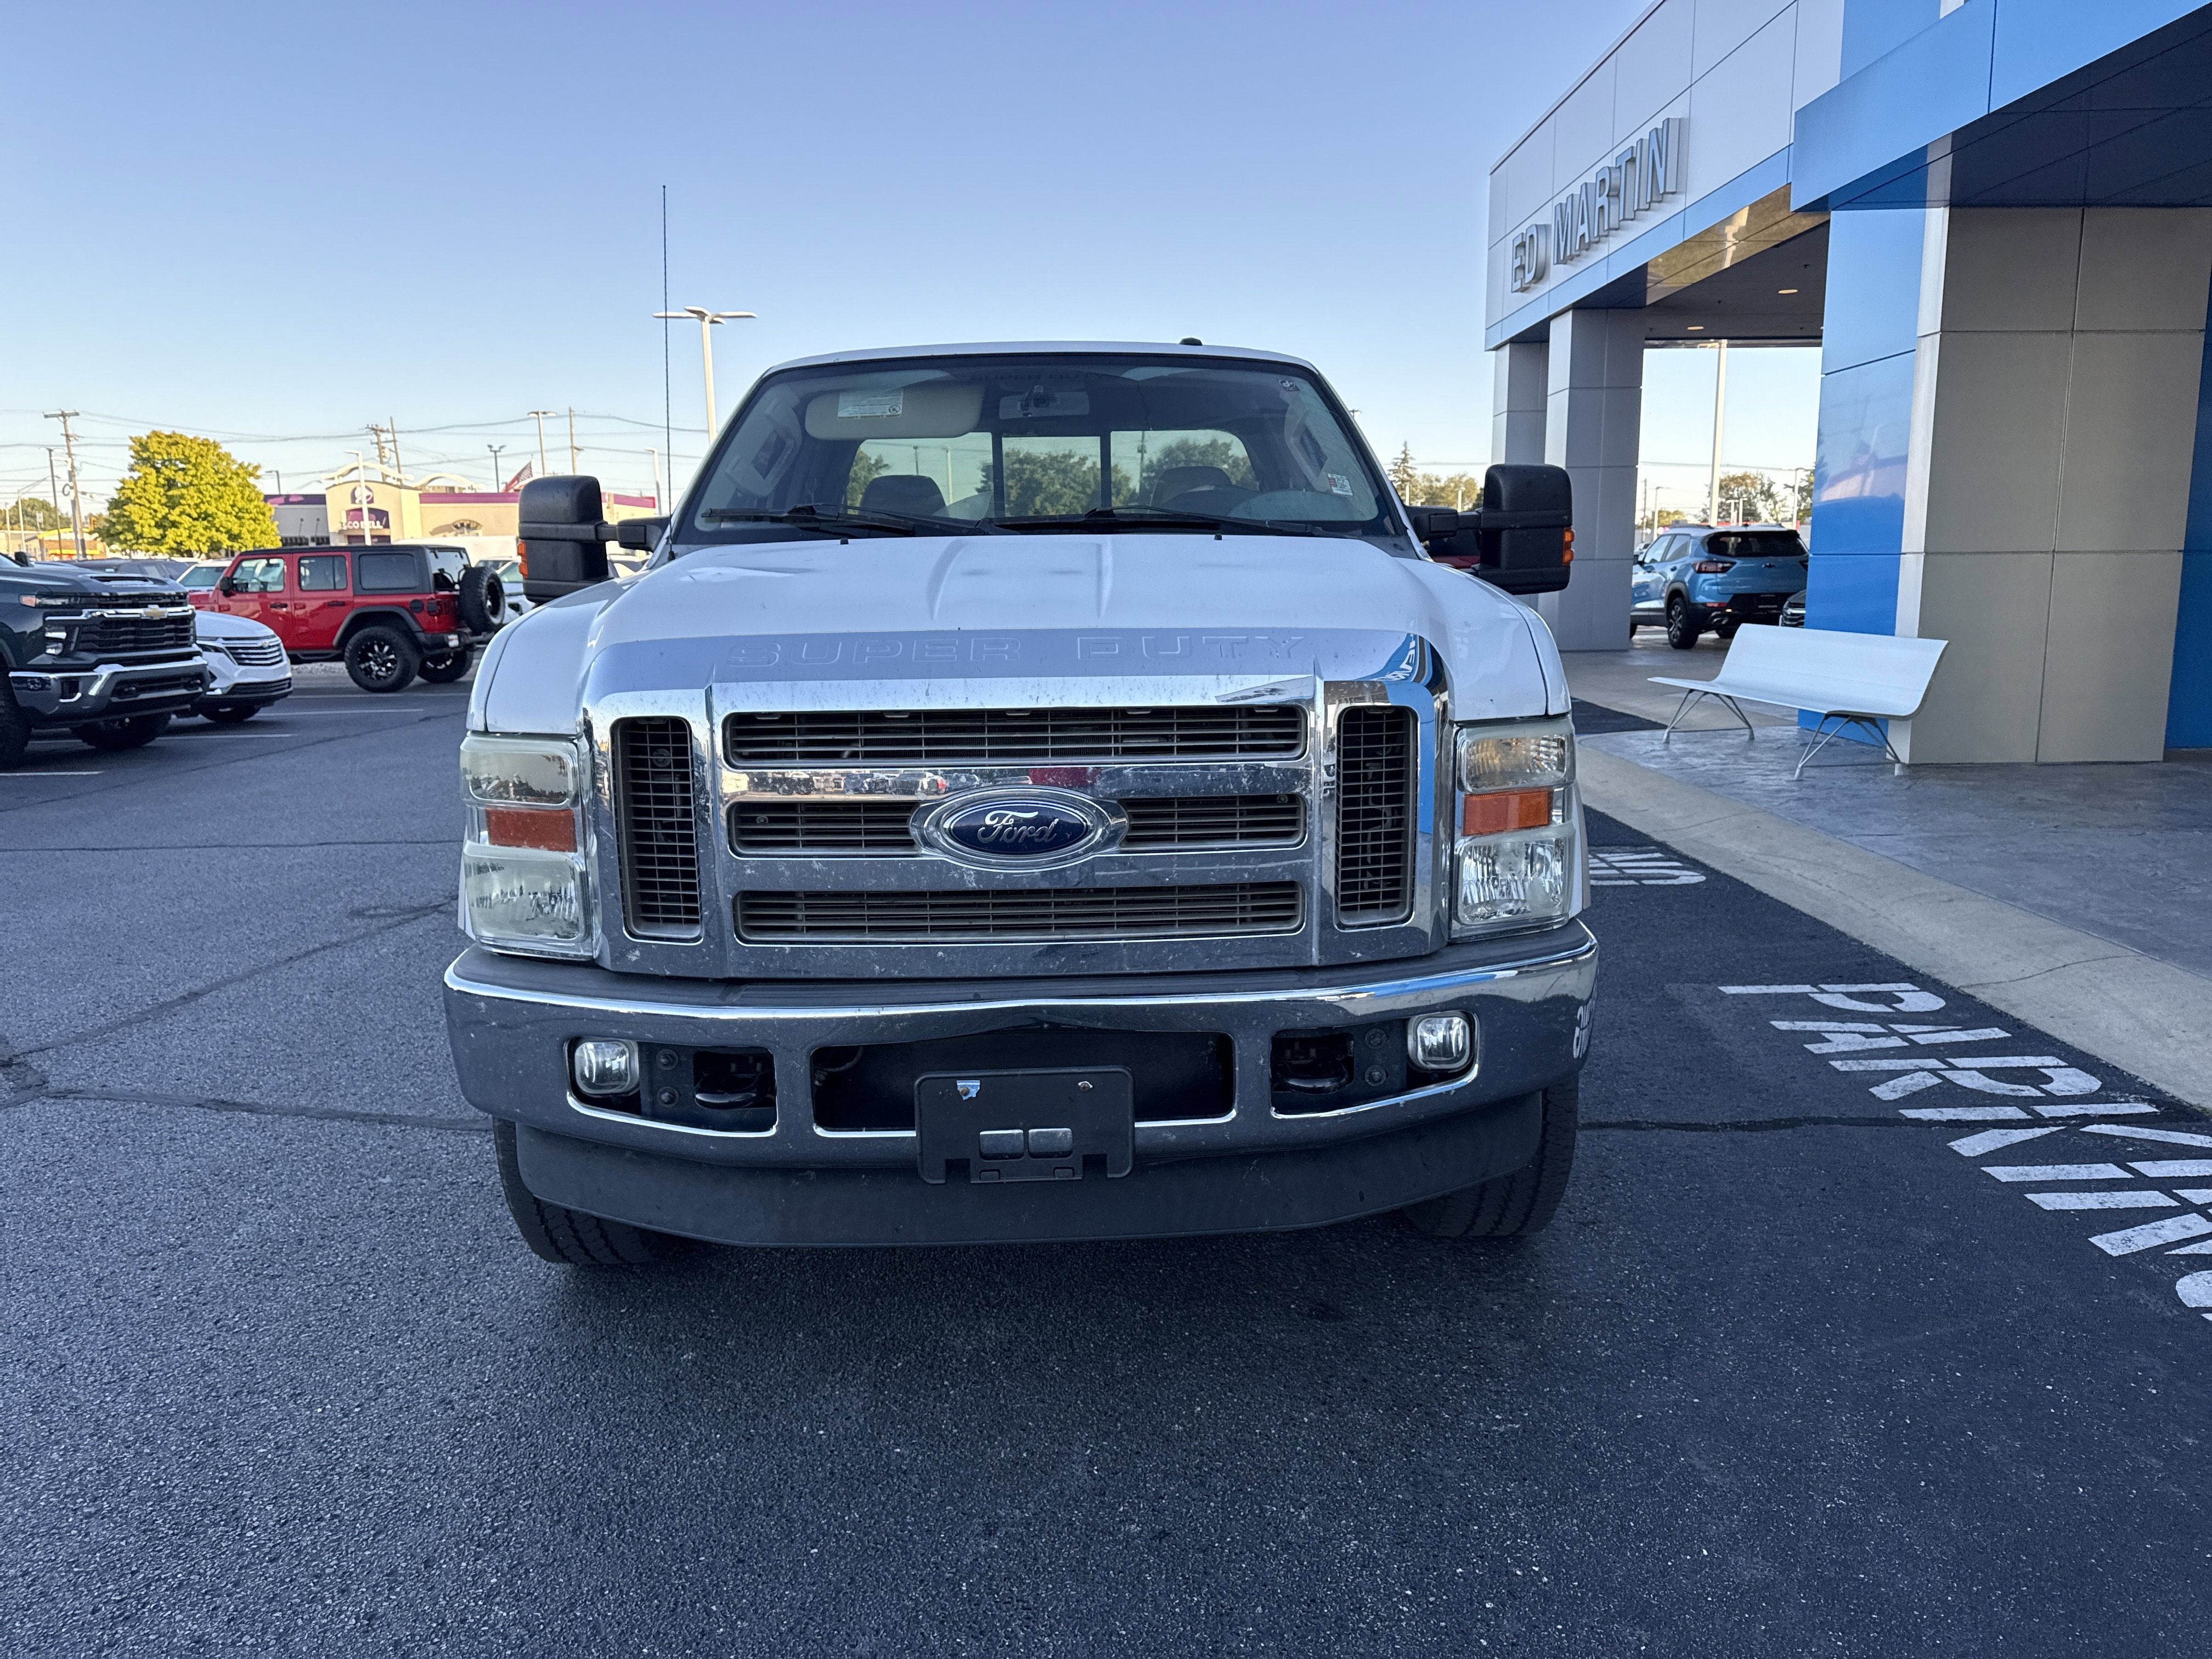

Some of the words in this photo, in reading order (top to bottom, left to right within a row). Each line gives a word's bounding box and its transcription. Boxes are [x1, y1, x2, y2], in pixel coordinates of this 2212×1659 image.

[1511, 223, 1548, 292] ED
[1553, 117, 1680, 265] MARTIN
[727, 636, 1021, 668] SUPER
[1076, 635, 1307, 661] DUTY
[977, 810, 1059, 843] Ford
[1718, 983, 2212, 1322] PARKIN
